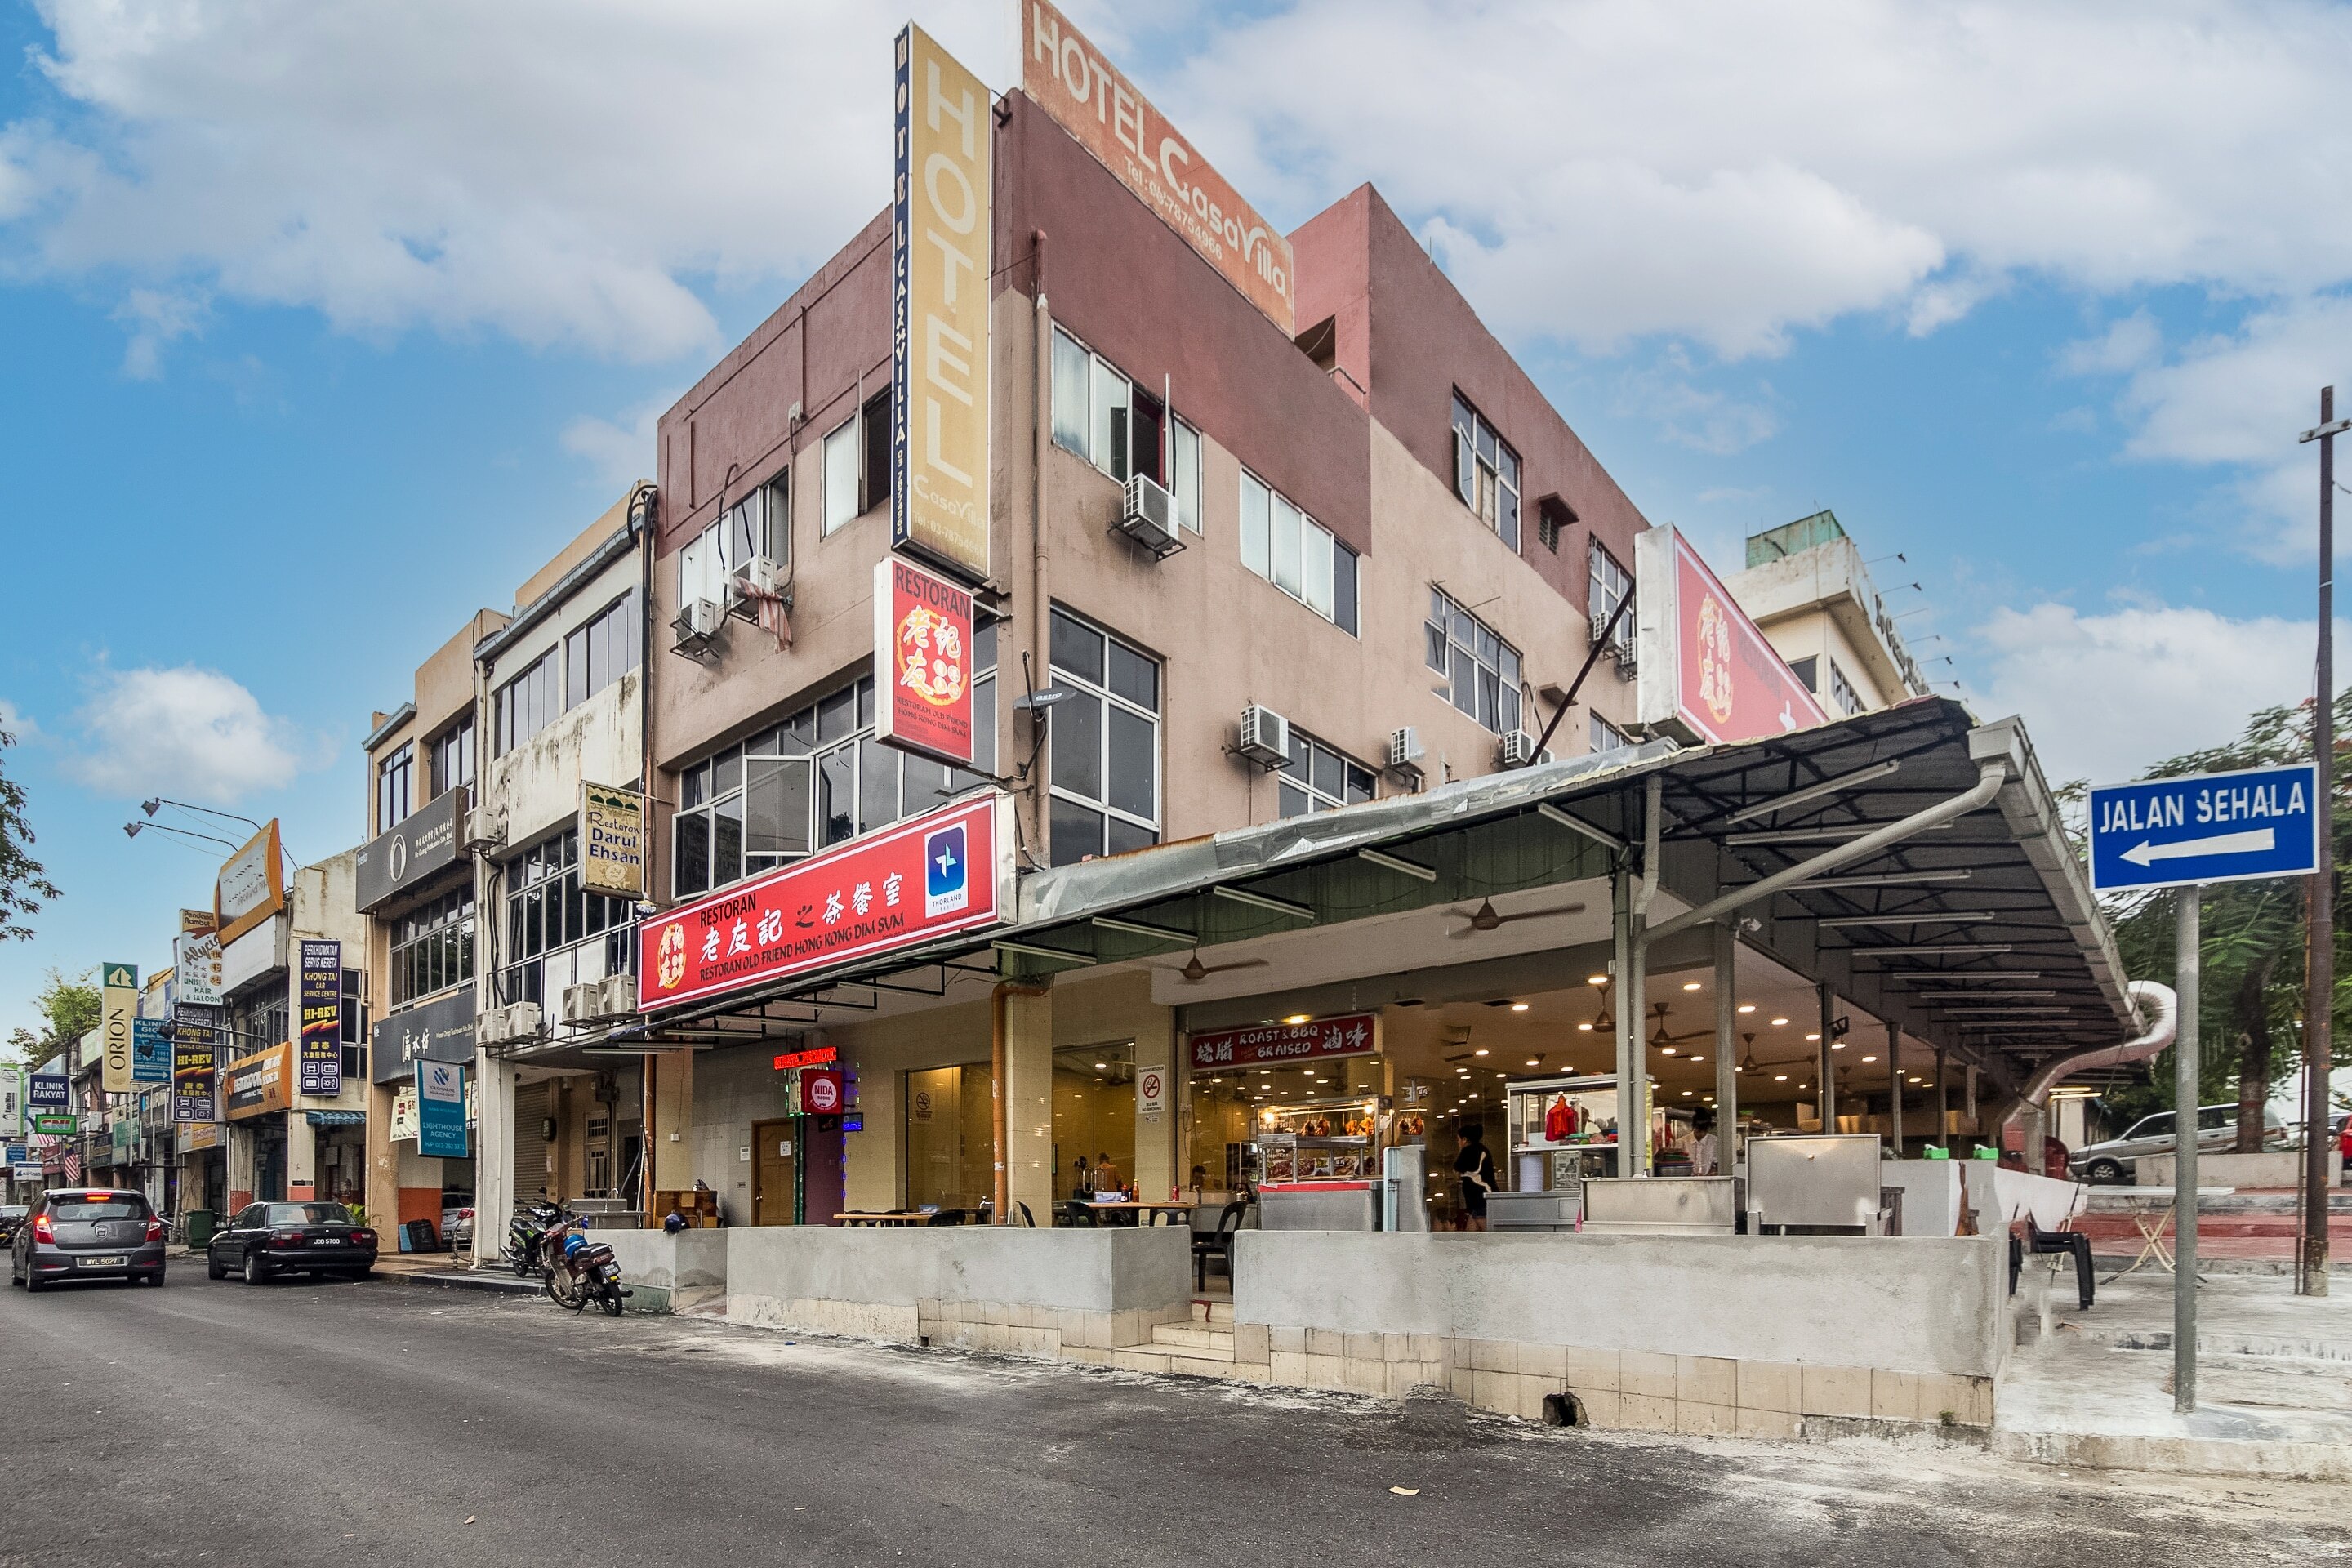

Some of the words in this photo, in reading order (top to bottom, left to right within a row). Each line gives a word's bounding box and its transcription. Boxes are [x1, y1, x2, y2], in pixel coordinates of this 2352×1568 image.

[1033, 2, 1156, 174] HOTEL
[897, 34, 907, 251] HOTEL
[924, 57, 977, 489] HOTEL
[895, 566, 969, 621] RESTORAN
[897, 696, 931, 715] RESTORAN
[932, 710, 945, 719] OLD
[898, 707, 917, 719] HONG
[918, 715, 937, 727] KONG
[938, 721, 951, 732] DIM
[951, 726, 967, 737] SUM
[2100, 794, 2185, 833] JALAN
[2196, 782, 2306, 824] SEHALA
[588, 811, 640, 835] Restoran
[592, 827, 636, 849] Darul
[590, 844, 639, 865] Ehsan
[932, 893, 962, 907] THORLAND
[700, 893, 757, 929] RESTORAN
[700, 959, 742, 981] RESTORAN
[742, 955, 760, 973] OLD
[760, 947, 794, 966] FRIEND
[795, 938, 822, 957] HONG
[823, 929, 853, 950] KONG
[854, 919, 875, 939] DIM
[877, 911, 905, 934] SUM
[304, 957, 321, 968] SERVIS
[320, 957, 337, 968] KERETA
[304, 972, 327, 981] KHONG
[327, 972, 338, 981] TAI
[193, 994, 220, 1003] SALOON
[194, 987, 212, 995] HAIR
[303, 990, 321, 998] SERVICE
[321, 990, 337, 998] CENTRE
[304, 1005, 337, 1020] HI-REV
[109, 1008, 126, 1070] ORION
[177, 1027, 201, 1037] KHONG
[203, 1029, 212, 1037] TAI
[1239, 1030, 1280, 1045] ROAST
[1281, 1030, 1289, 1040] &
[1290, 1026, 1319, 1038] BBQ
[1257, 1041, 1312, 1058] BRAISED
[177, 1054, 212, 1065] HI-REV
[33, 1090, 65, 1099] RAKYAT
[34, 1081, 65, 1091] KLINIK
[814, 1085, 833, 1095] NIDA
[423, 1122, 463, 1133] LIGHTHOUSE
[430, 1130, 457, 1138] AGENCY
